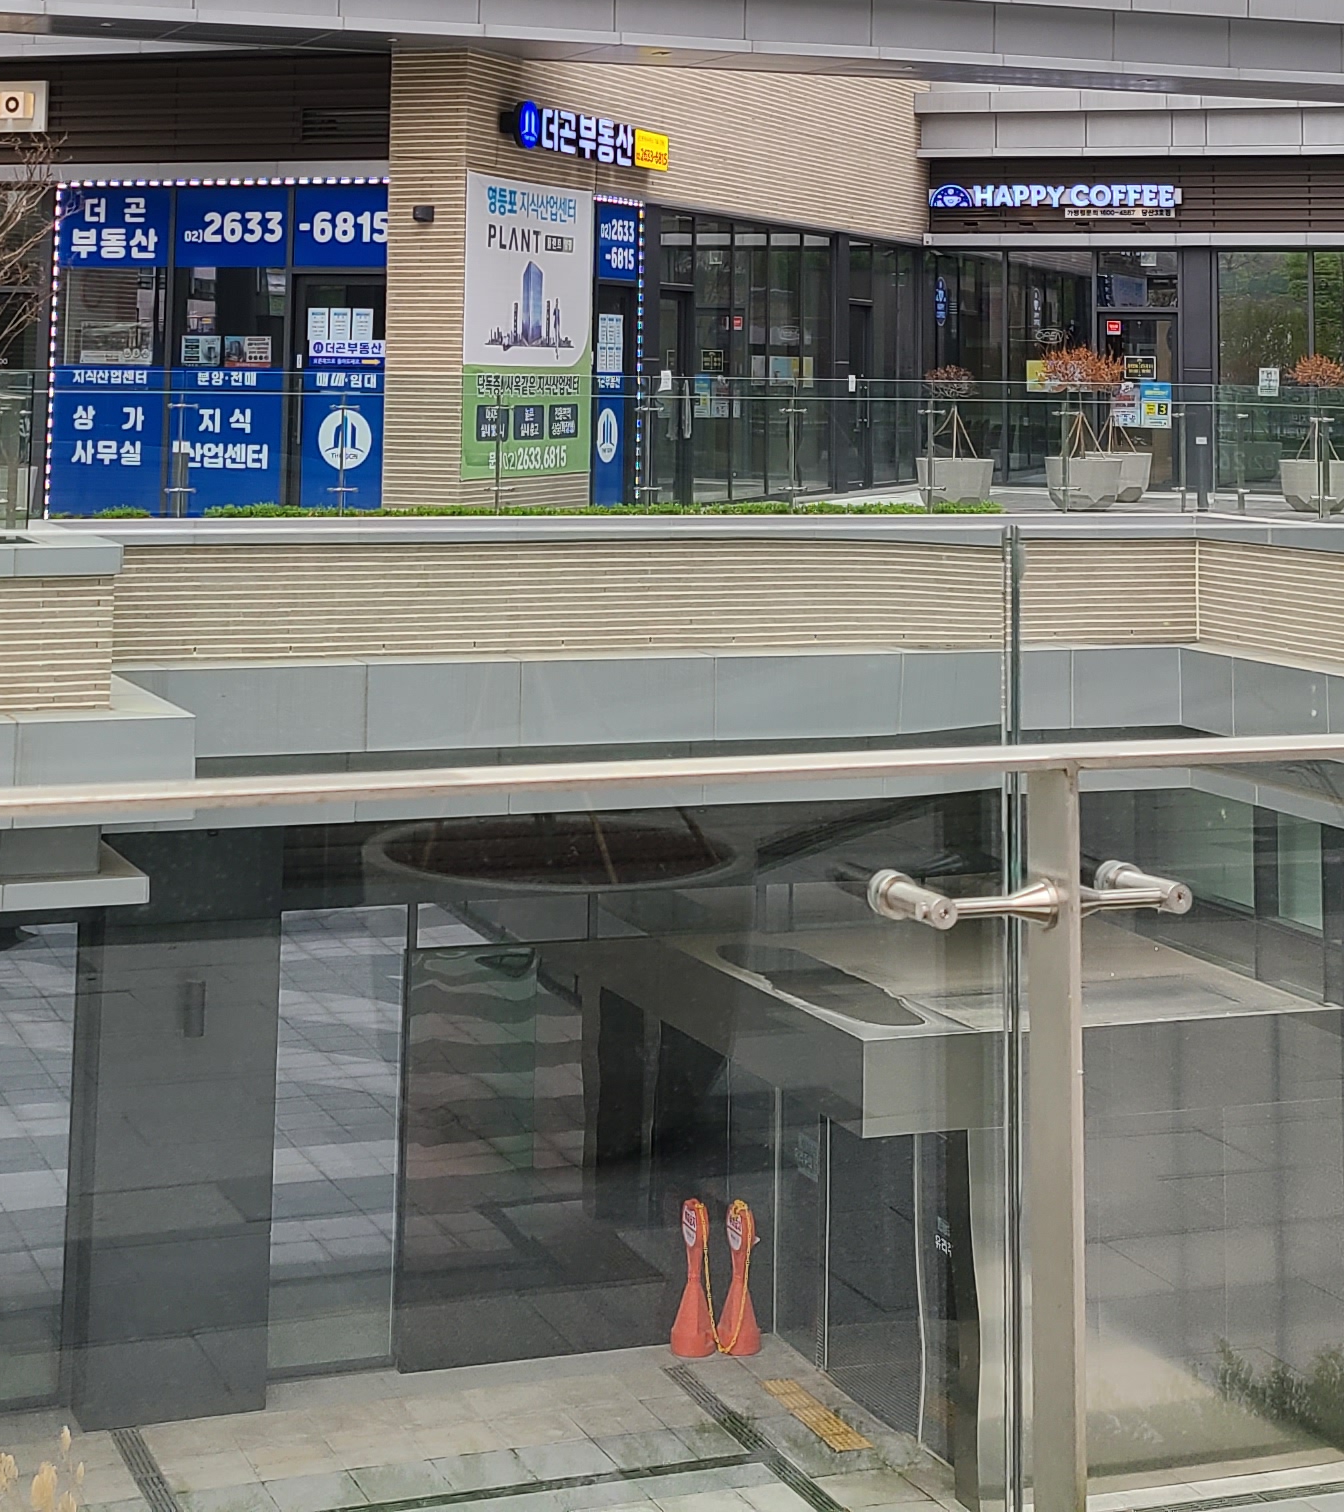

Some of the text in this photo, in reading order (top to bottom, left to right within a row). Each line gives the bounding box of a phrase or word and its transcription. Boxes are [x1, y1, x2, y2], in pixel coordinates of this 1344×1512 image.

[541, 108, 634, 167] 더곤부동산
[487, 185, 577, 224] 영등포 지식산업센터
[971, 184, 1176, 208] HAPPY COFFEE
[70, 228, 159, 260] 부동산
[487, 224, 542, 254] PLANT
[605, 248, 635, 271] -6815
[325, 342, 382, 355] 더곤부동산
[72, 369, 148, 385] 지식산업센터
[536, 375, 580, 396] 지식산업센터
[1158, 404, 1168, 415] 3
[71, 440, 143, 467] 사무실
